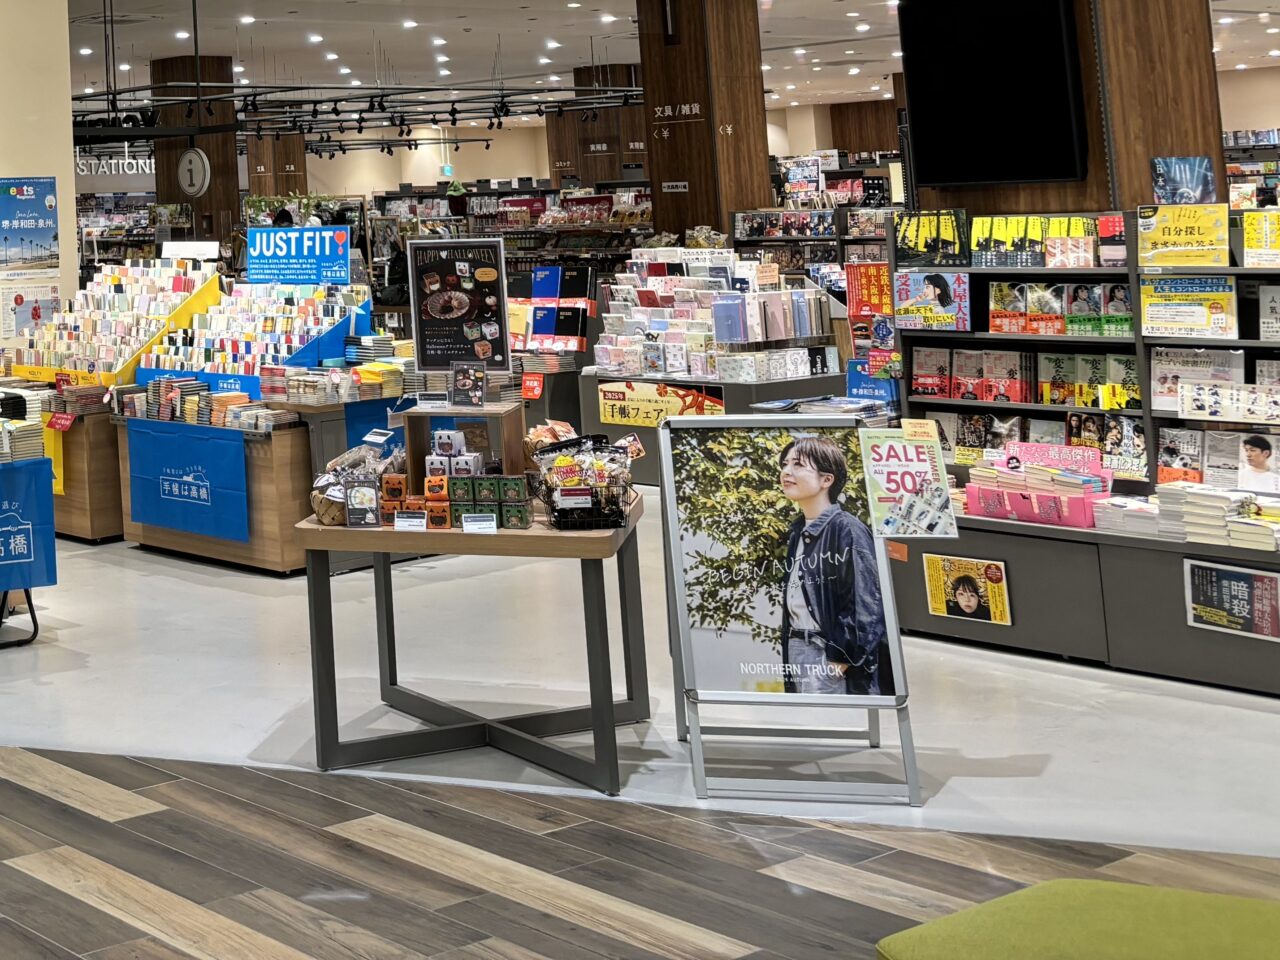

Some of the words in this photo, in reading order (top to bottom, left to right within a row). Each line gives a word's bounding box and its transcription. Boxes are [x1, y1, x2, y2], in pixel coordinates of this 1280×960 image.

[249, 231, 300, 257] JUST
[1162, 226, 1205, 236] 自分探し
[416, 250, 441, 266] HAPPY
[447, 248, 496, 264] HALLOWEEN
[868, 266, 880, 304] 南大阪線
[880, 265, 891, 314] 近鉄大阪線
[896, 273, 911, 302] 受賞
[952, 273, 968, 331] 本屋大賞
[870, 444, 927, 463] SALE
[926, 445, 940, 483] SUMMER
[162, 481, 209, 500] 手帳は高橋
[708, 560, 768, 586] BEGIN
[772, 546, 850, 576] AUTUMN
[1231, 581, 1251, 618] 暗殺
[740, 663, 801, 675] NORTHERN
[805, 664, 844, 676] TRUCK
